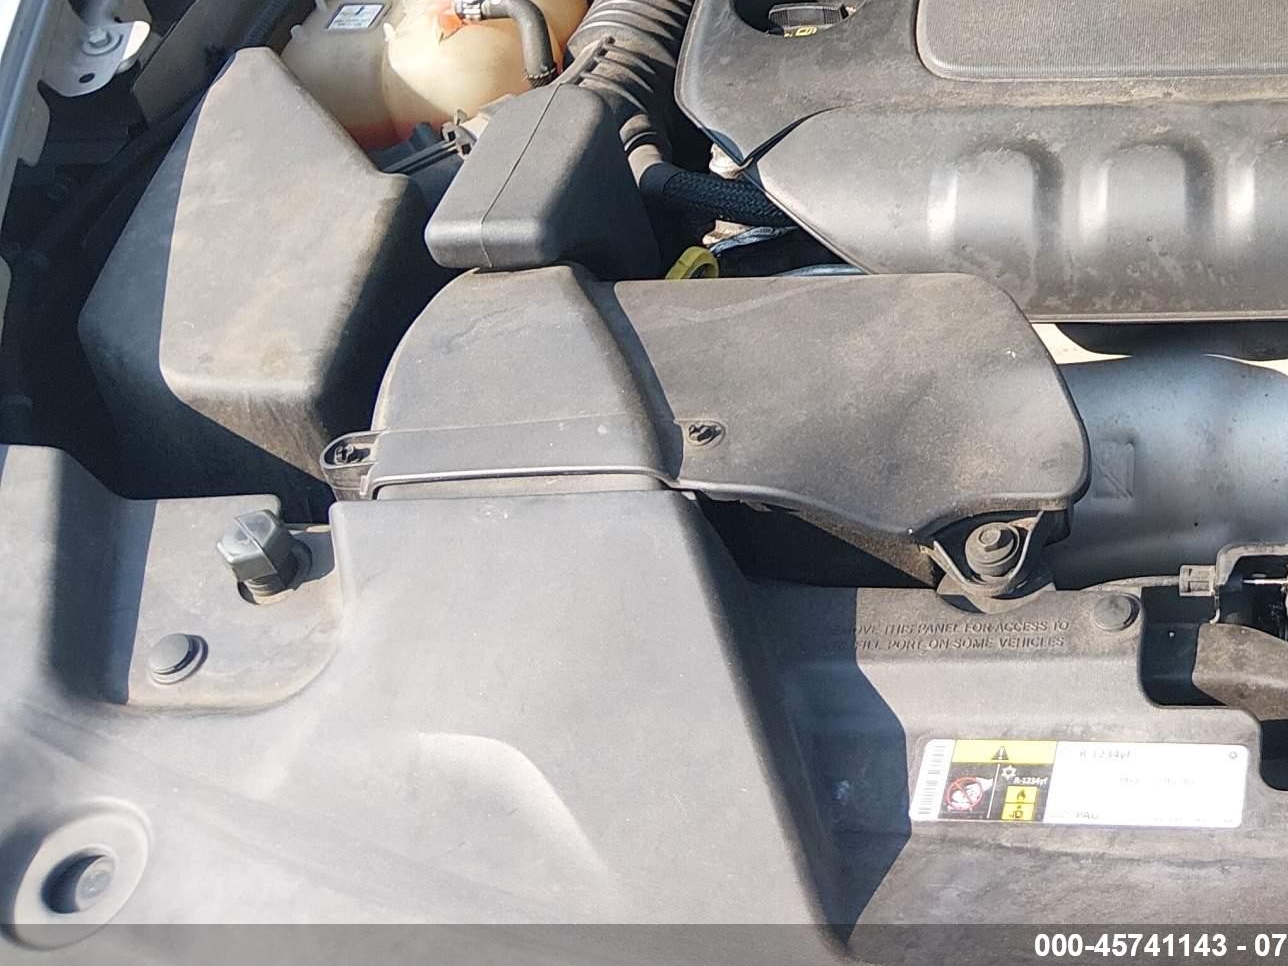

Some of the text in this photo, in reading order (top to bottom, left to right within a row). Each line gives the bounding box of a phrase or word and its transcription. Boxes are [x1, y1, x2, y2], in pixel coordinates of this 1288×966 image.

[884, 623, 914, 635] THIS
[918, 623, 958, 635] PANEL
[964, 622, 993, 633] FOR
[995, 620, 1048, 633] ACCESS
[1054, 620, 1070, 631] TO
[887, 639, 924, 650] PORT
[928, 638, 950, 650] ON
[952, 637, 993, 649] SOME
[999, 636, 1065, 648] VEHICLES
